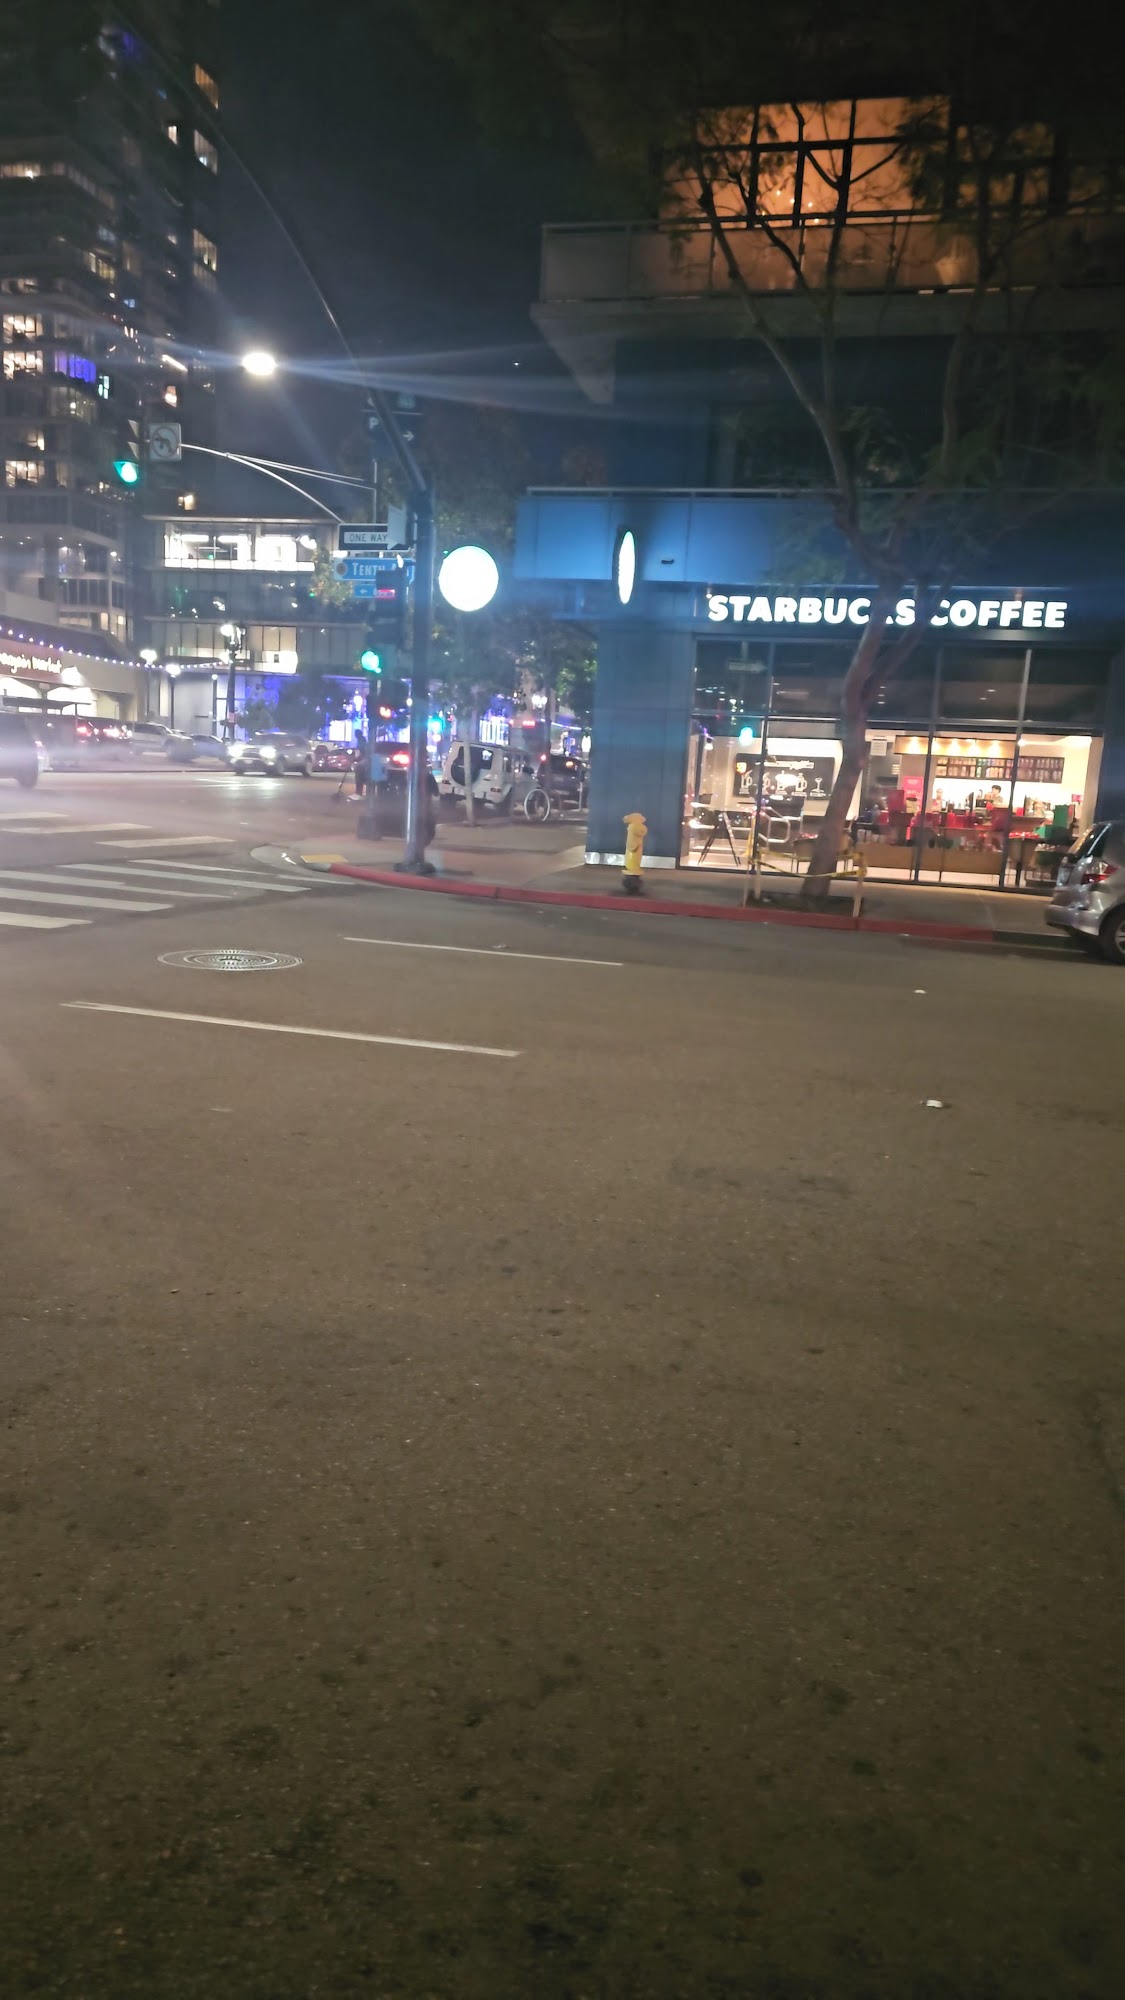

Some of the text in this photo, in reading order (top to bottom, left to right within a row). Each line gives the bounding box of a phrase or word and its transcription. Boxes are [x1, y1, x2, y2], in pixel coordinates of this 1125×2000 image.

[349, 533, 387, 543] ONE WAY
[707, 594, 916, 626] STARBUCS
